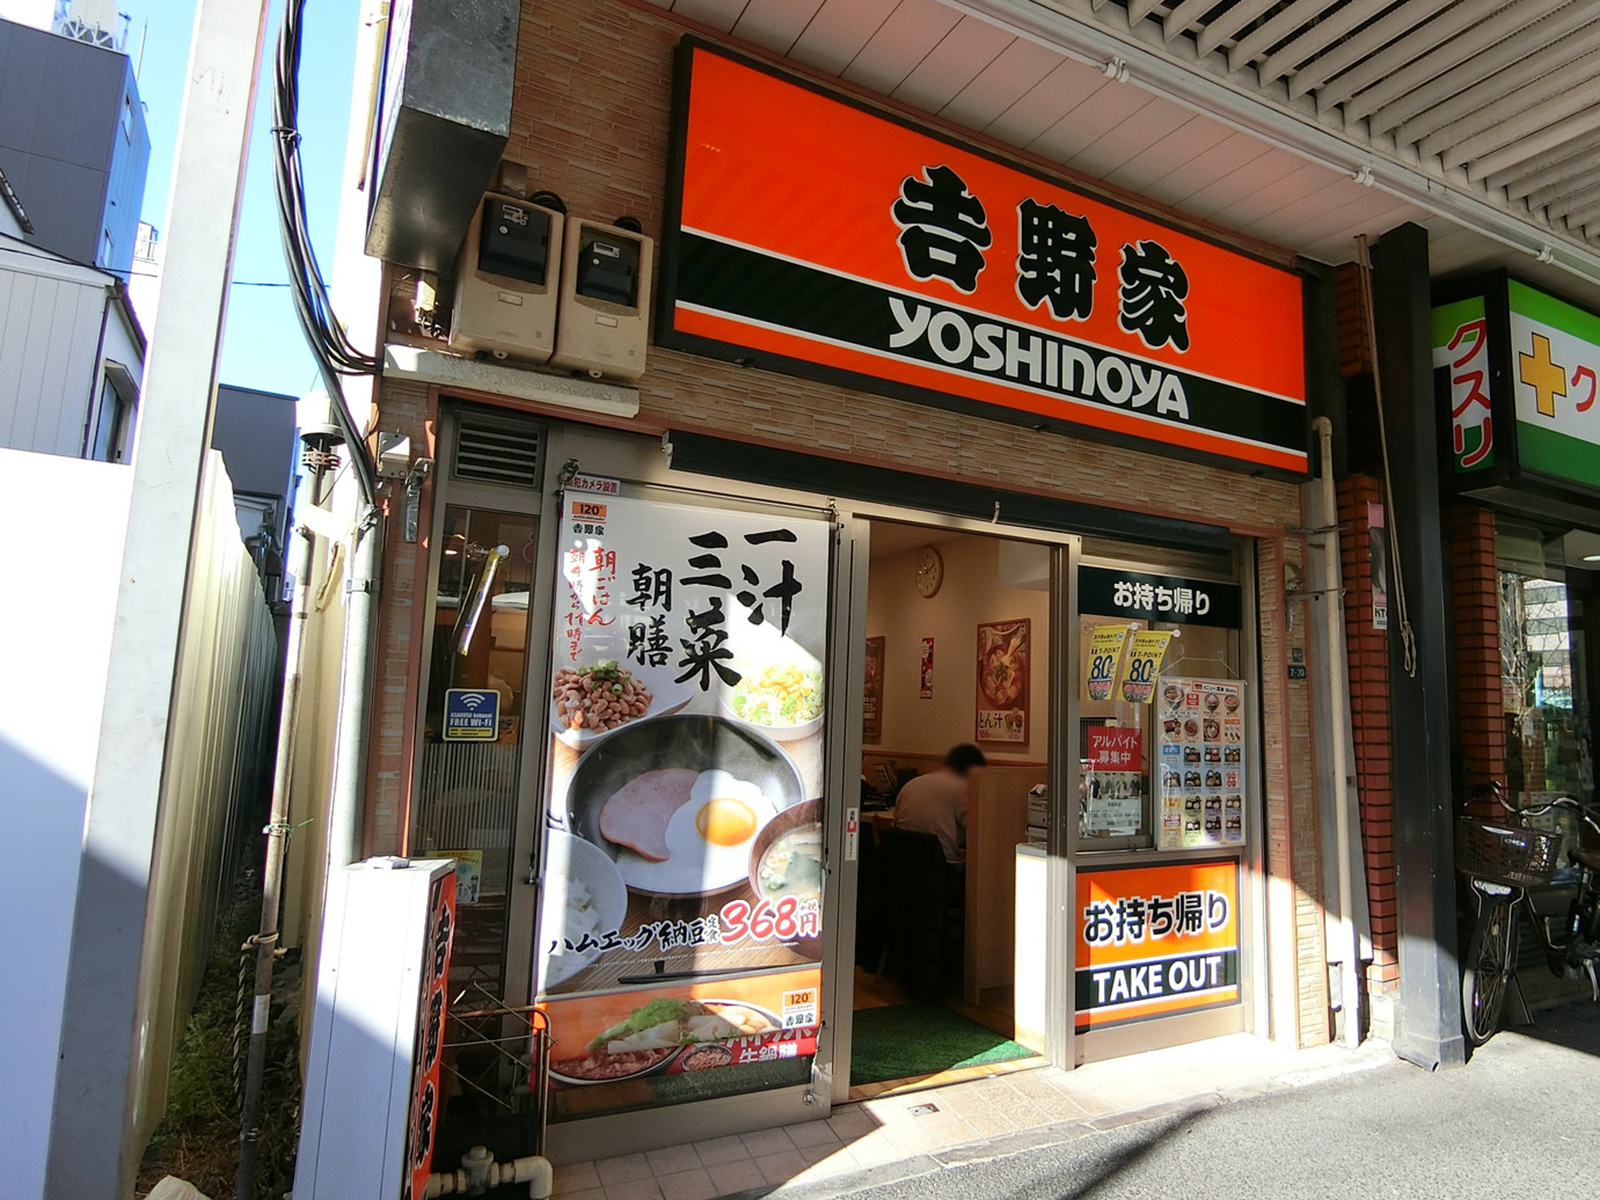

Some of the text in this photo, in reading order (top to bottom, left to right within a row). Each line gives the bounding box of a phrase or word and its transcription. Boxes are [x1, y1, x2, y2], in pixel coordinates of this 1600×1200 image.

[890, 164, 1190, 354] 吉野家
[888, 296, 1190, 420] YOSHINOYA
[1448, 317, 1494, 467] クスリ
[1571, 365, 1597, 412] ク
[588, 546, 617, 626] 朝ごはん
[1113, 580, 1211, 616] お持ち帰り
[450, 718, 469, 727] FREE
[1092, 735, 1138, 750] アルバイト
[1099, 749, 1132, 764] 募集中
[1083, 890, 1229, 946] お持ち帰り
[1093, 955, 1222, 1003] TAKE OUT
